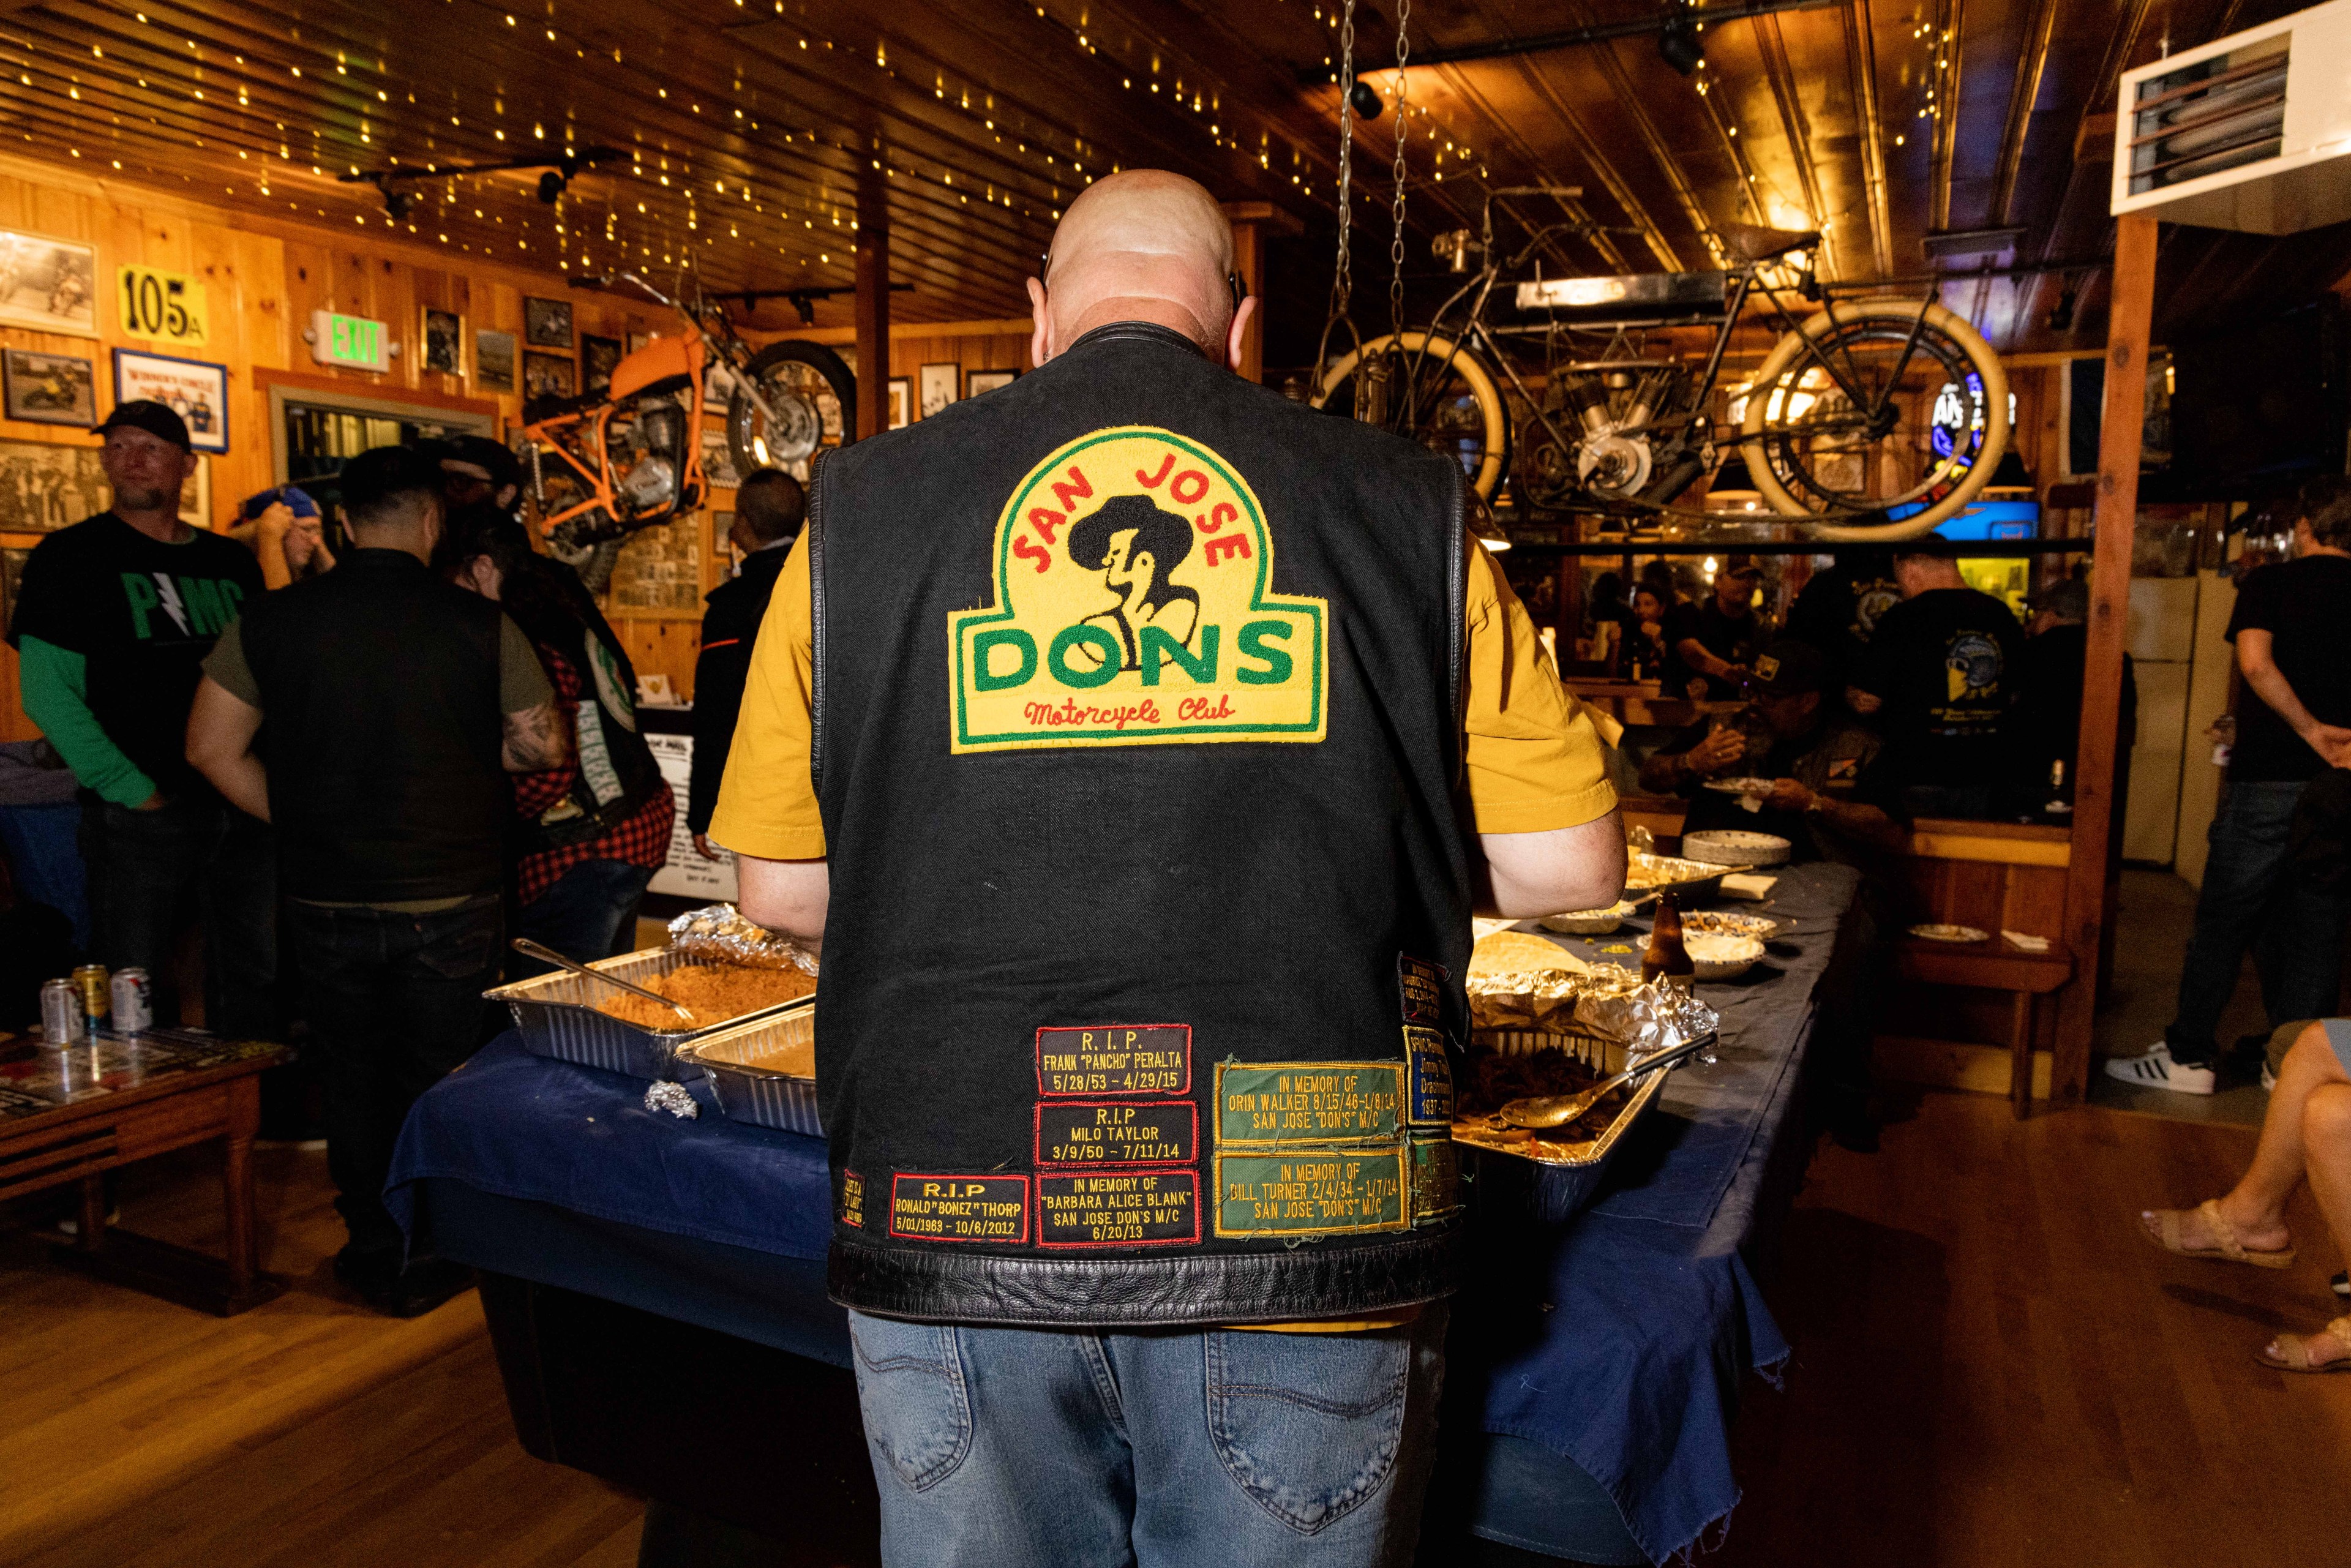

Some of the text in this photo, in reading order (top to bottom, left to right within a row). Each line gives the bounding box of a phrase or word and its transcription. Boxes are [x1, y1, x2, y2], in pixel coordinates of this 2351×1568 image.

[332, 315, 379, 364] EXIT
[1013, 453, 1252, 573] SAN JOSE
[973, 620, 1293, 692] DONS
[1024, 694, 1235, 730] Motorcycle Club
[1044, 1051, 1182, 1071] FRANK "PANCHO" PERALTA
[1054, 1074, 1106, 1092] 5/28/53
[1124, 1071, 1178, 1090] 4/29/15
[1280, 1075, 1358, 1093] IN MEMORY OF
[1229, 1094, 1255, 1111] ORIN
[1261, 1093, 1309, 1111] WALKER
[1422, 1099, 1438, 1115] 1937
[1097, 1108, 1135, 1125] R.I.P
[1253, 1111, 1379, 1130] SAN JOSE "DON'S" M/C
[1071, 1127, 1159, 1142] MILO TAYLOR
[1053, 1144, 1103, 1160] 3/9/50
[1124, 1142, 1179, 1159] 7/11/14
[1280, 1162, 1360, 1182] IN MEMORY OF
[923, 1182, 986, 1198] R.I.P
[1074, 1177, 1158, 1193] IN MEMORY OF
[1230, 1183, 1258, 1201] BILL
[1261, 1183, 1307, 1200] TURNER
[1312, 1180, 1354, 1200] 2/4/34
[1367, 1178, 1398, 1197] 1/7/14
[896, 1199, 931, 1214] RONALD
[981, 1202, 1021, 1217] THORP
[1041, 1191, 1192, 1209] "BARBARA ALICE BLANK"
[1254, 1198, 1382, 1219] SAN JOSE "DON'S" M/C
[896, 1217, 943, 1232] 5/01/1963
[956, 1220, 1015, 1236] 10/6/2012
[1054, 1209, 1179, 1226] SAN JOSE DON'S M/C
[1093, 1225, 1143, 1240] 6/20/13
